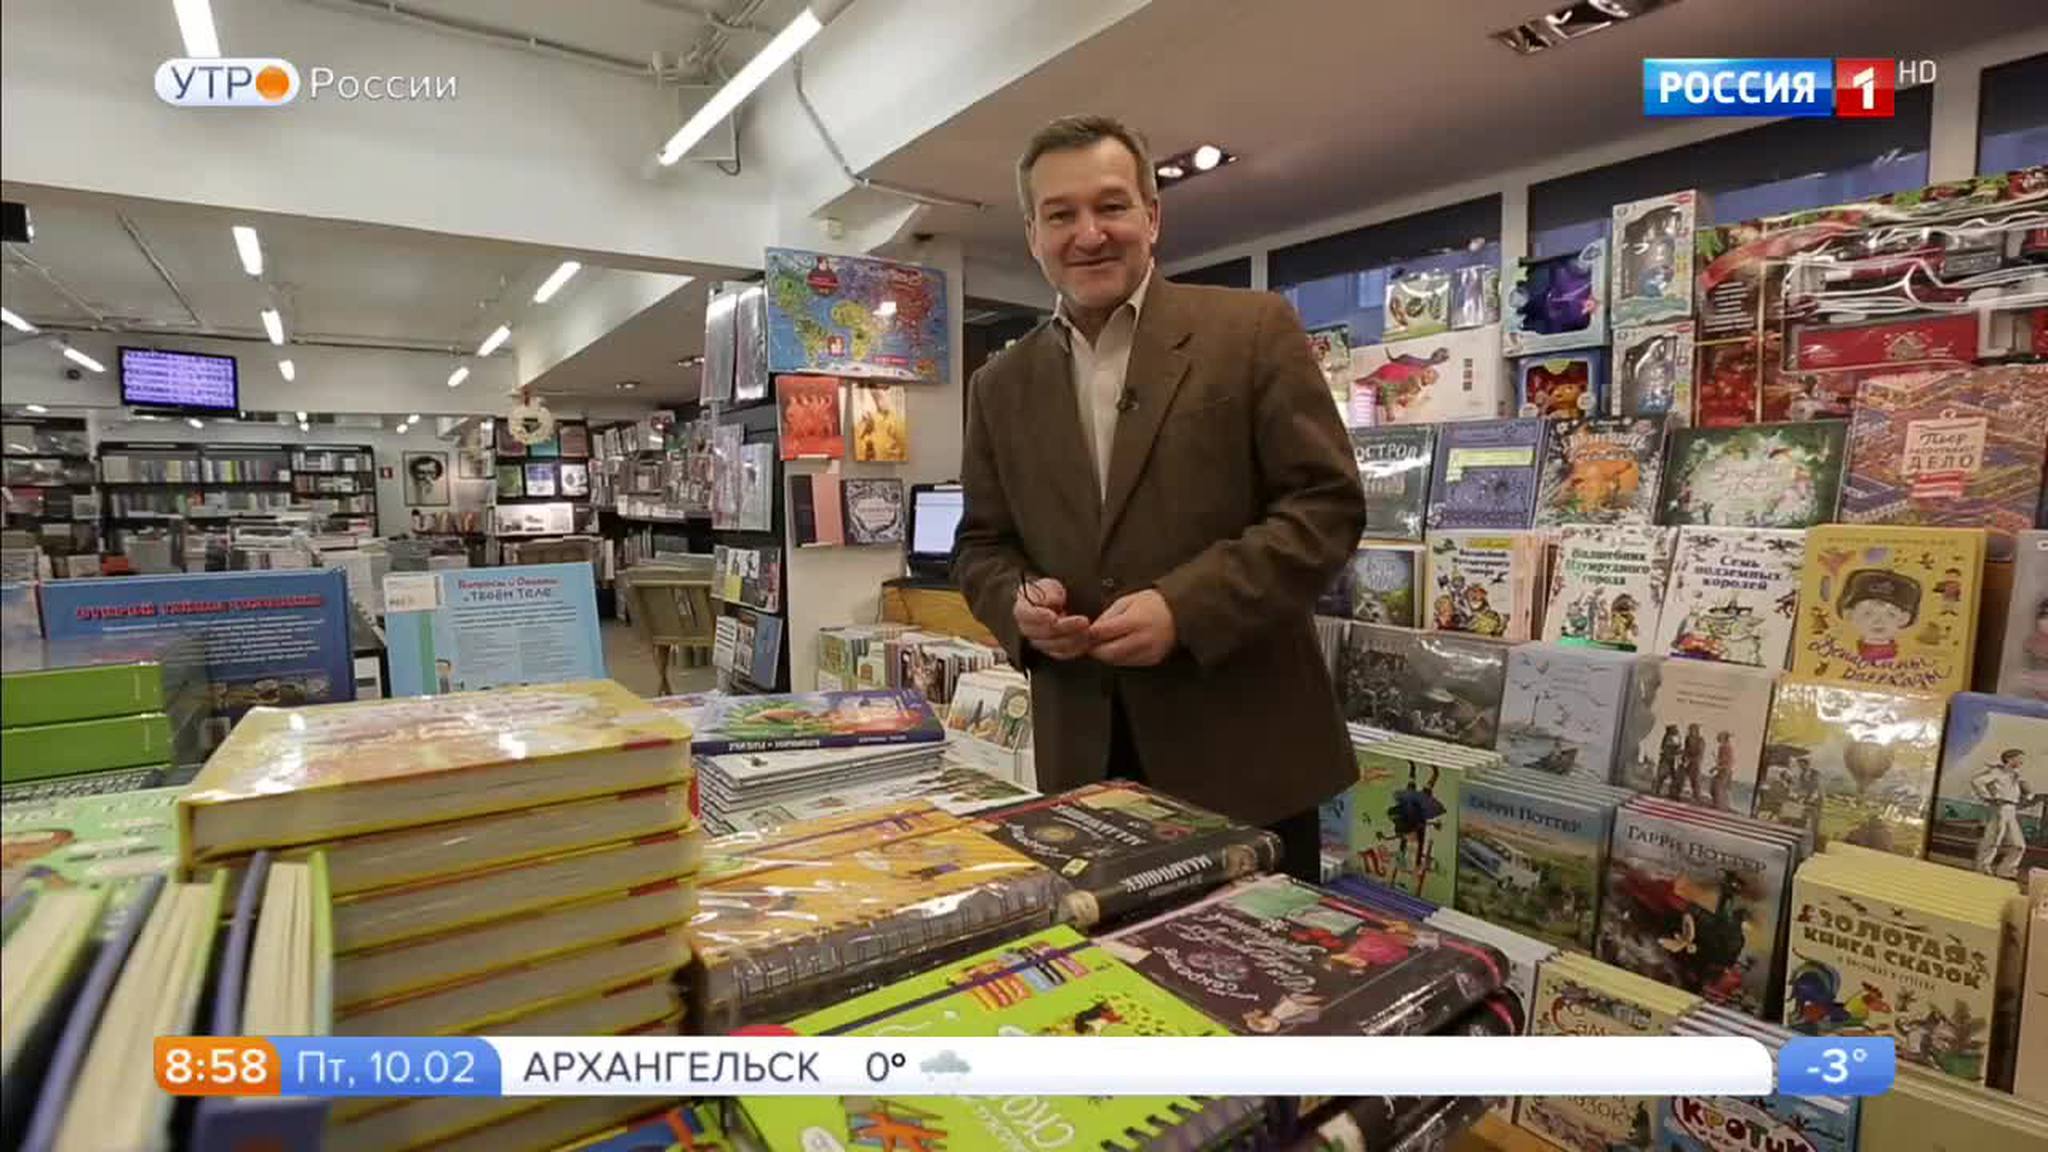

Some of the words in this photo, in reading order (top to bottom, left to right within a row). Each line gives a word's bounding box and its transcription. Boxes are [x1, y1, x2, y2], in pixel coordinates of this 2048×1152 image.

[1719, 554, 1760, 569] Семь
[1803, 926, 1877, 960] КНИГА
[1883, 949, 1982, 991] СКАЗОК
[1818, 907, 1968, 966] ЗОЛОТАЯ
